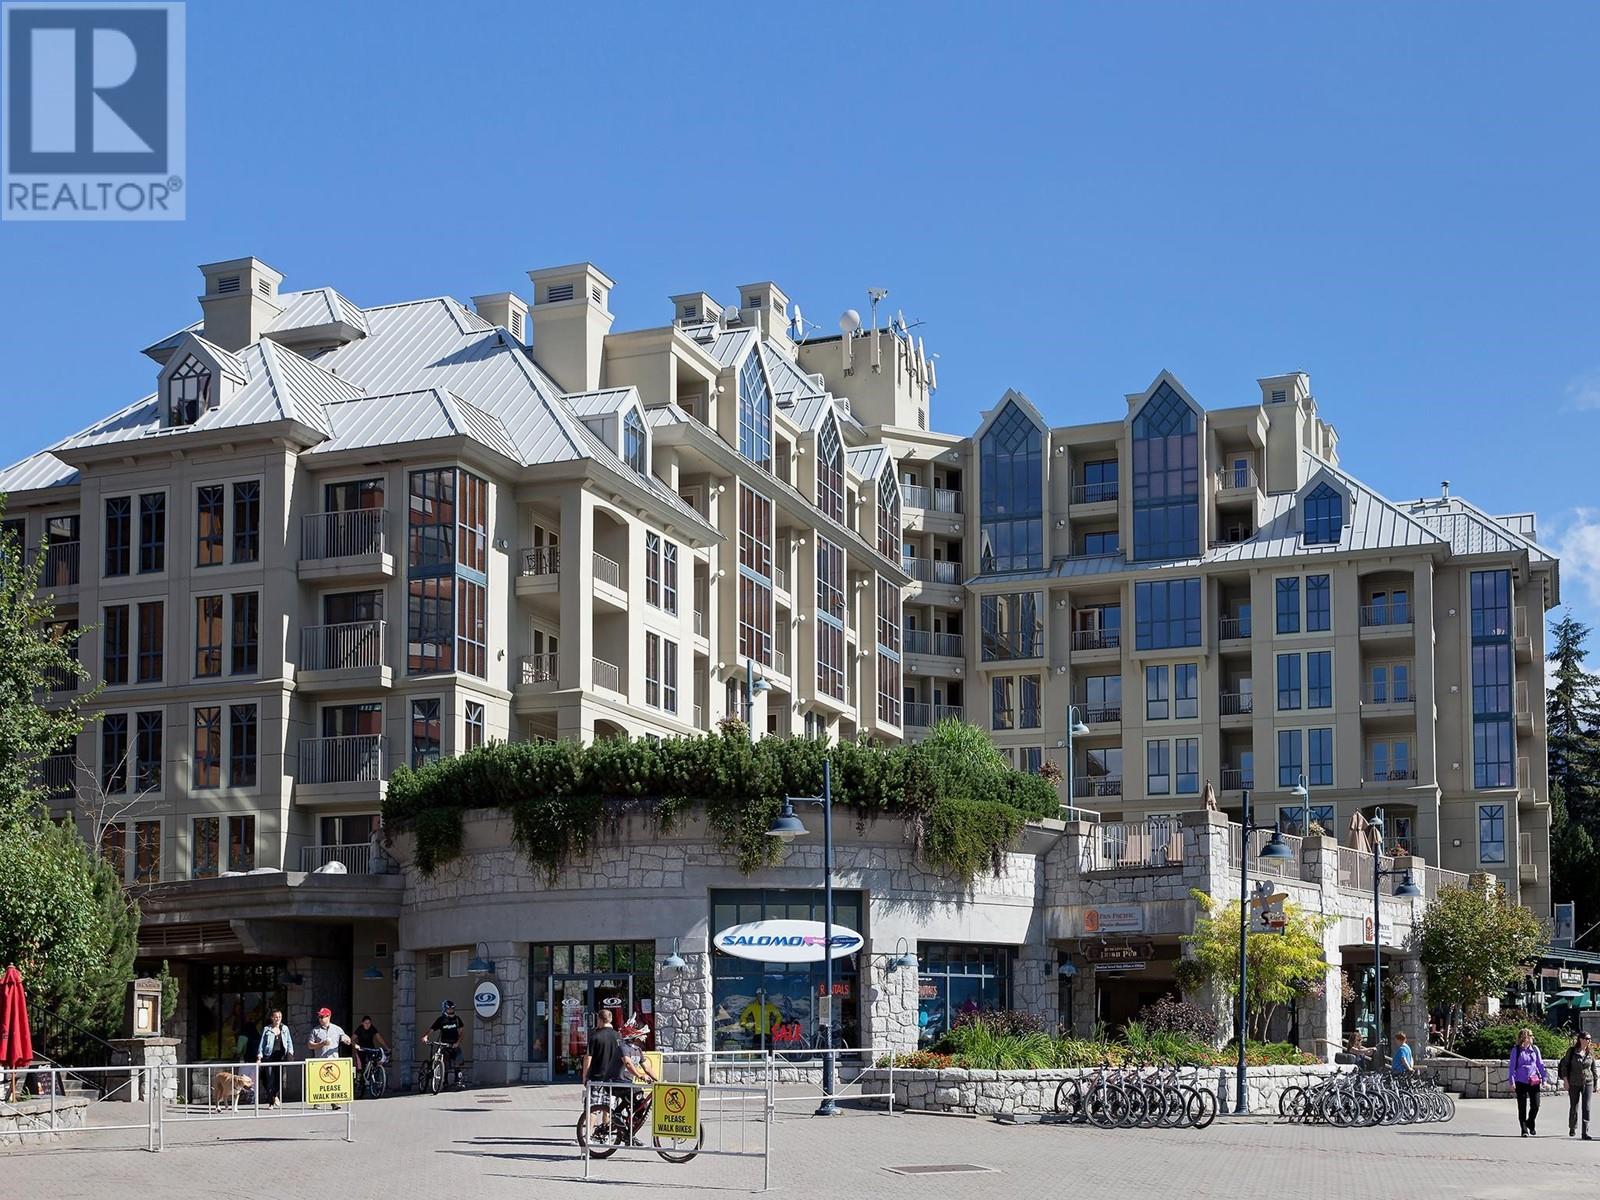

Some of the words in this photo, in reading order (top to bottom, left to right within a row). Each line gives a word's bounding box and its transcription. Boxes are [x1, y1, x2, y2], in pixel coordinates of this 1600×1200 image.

[721, 935, 813, 947] SALOMO
[664, 1115, 686, 1123] PLEASE
[658, 1124, 674, 1132] WALK
[675, 1125, 692, 1133] BIKES
